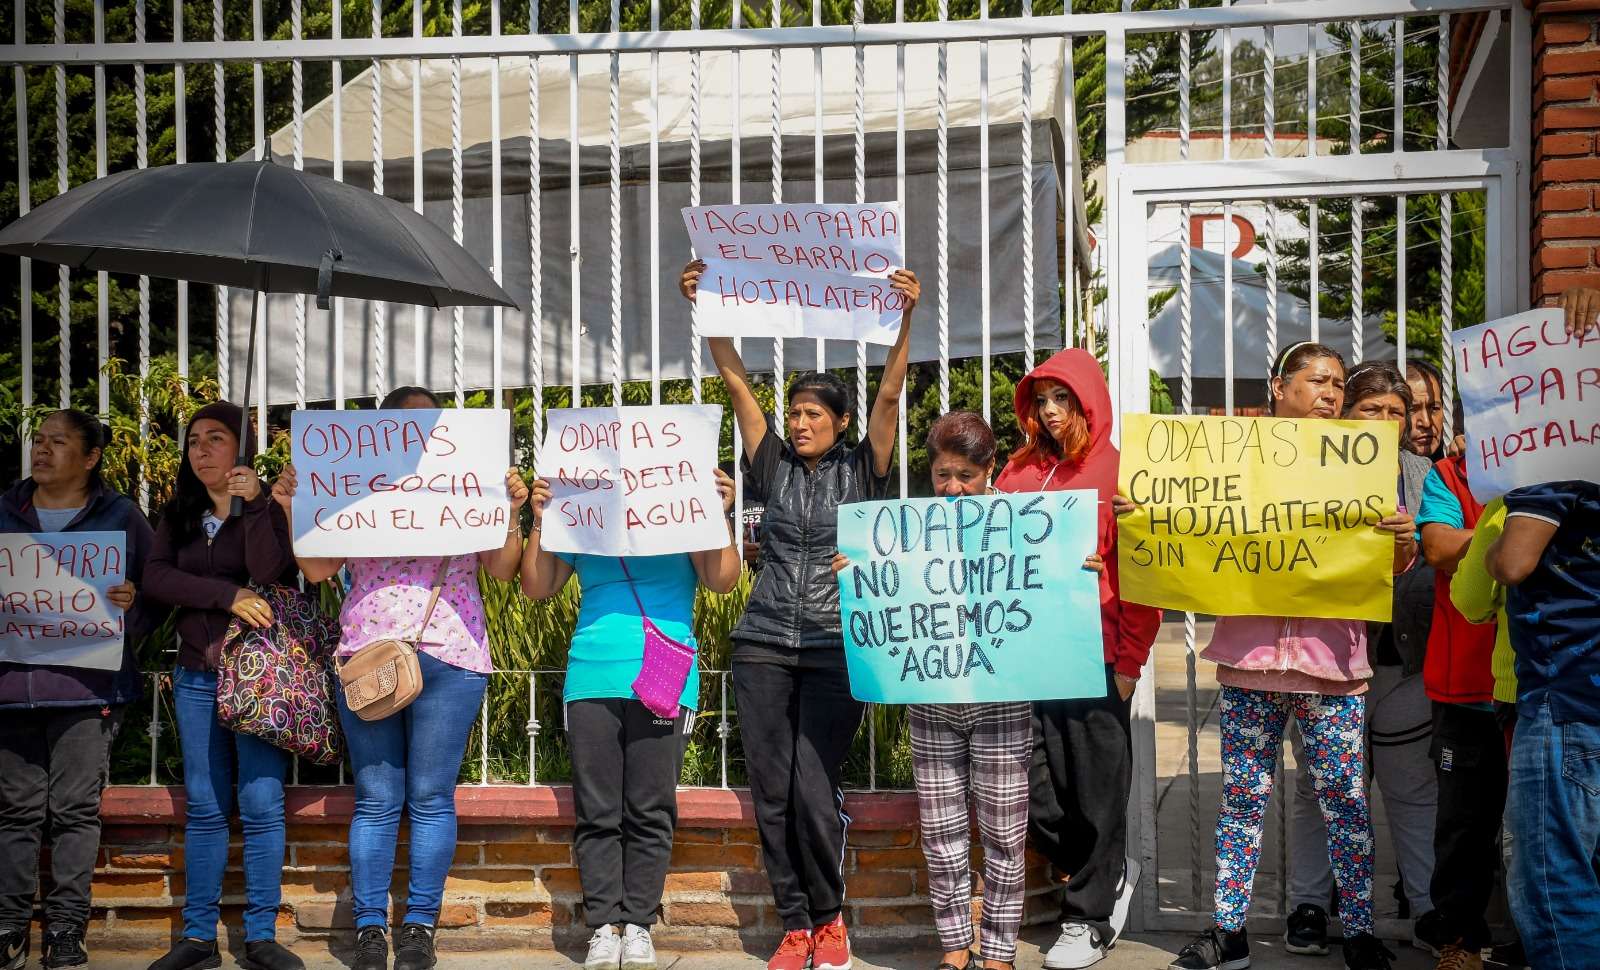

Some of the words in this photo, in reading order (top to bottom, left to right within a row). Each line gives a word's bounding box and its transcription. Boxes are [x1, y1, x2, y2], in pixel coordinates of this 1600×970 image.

[804, 208, 897, 239] PARA
[718, 243, 763, 261] EL
[767, 244, 890, 273] BARRIO
[302, 417, 456, 463] ODAPAS
[559, 420, 682, 453] ODAPAS
[1146, 419, 1298, 467] ODAPAS
[1320, 431, 1379, 467] NO
[310, 471, 482, 498] NEGOCIA
[558, 466, 614, 491] NOS
[619, 460, 697, 496] DEJA
[1130, 470, 1242, 505] CUMPLE
[314, 507, 376, 532] CON
[392, 509, 425, 530] EL
[439, 506, 505, 530] AGUA
[560, 501, 604, 529] SIN
[626, 497, 707, 530] AGUA
[1150, 495, 1383, 537] HOJALATEROS
[20, 542, 120, 579] PARA
[1131, 540, 1184, 568] SIN
[853, 559, 900, 599] NO
[924, 552, 1043, 596] CUMPLE
[0, 588, 96, 614] RRIO
[0, 615, 122, 640] ATEROS!
[850, 598, 1033, 648] QUEREMOS
